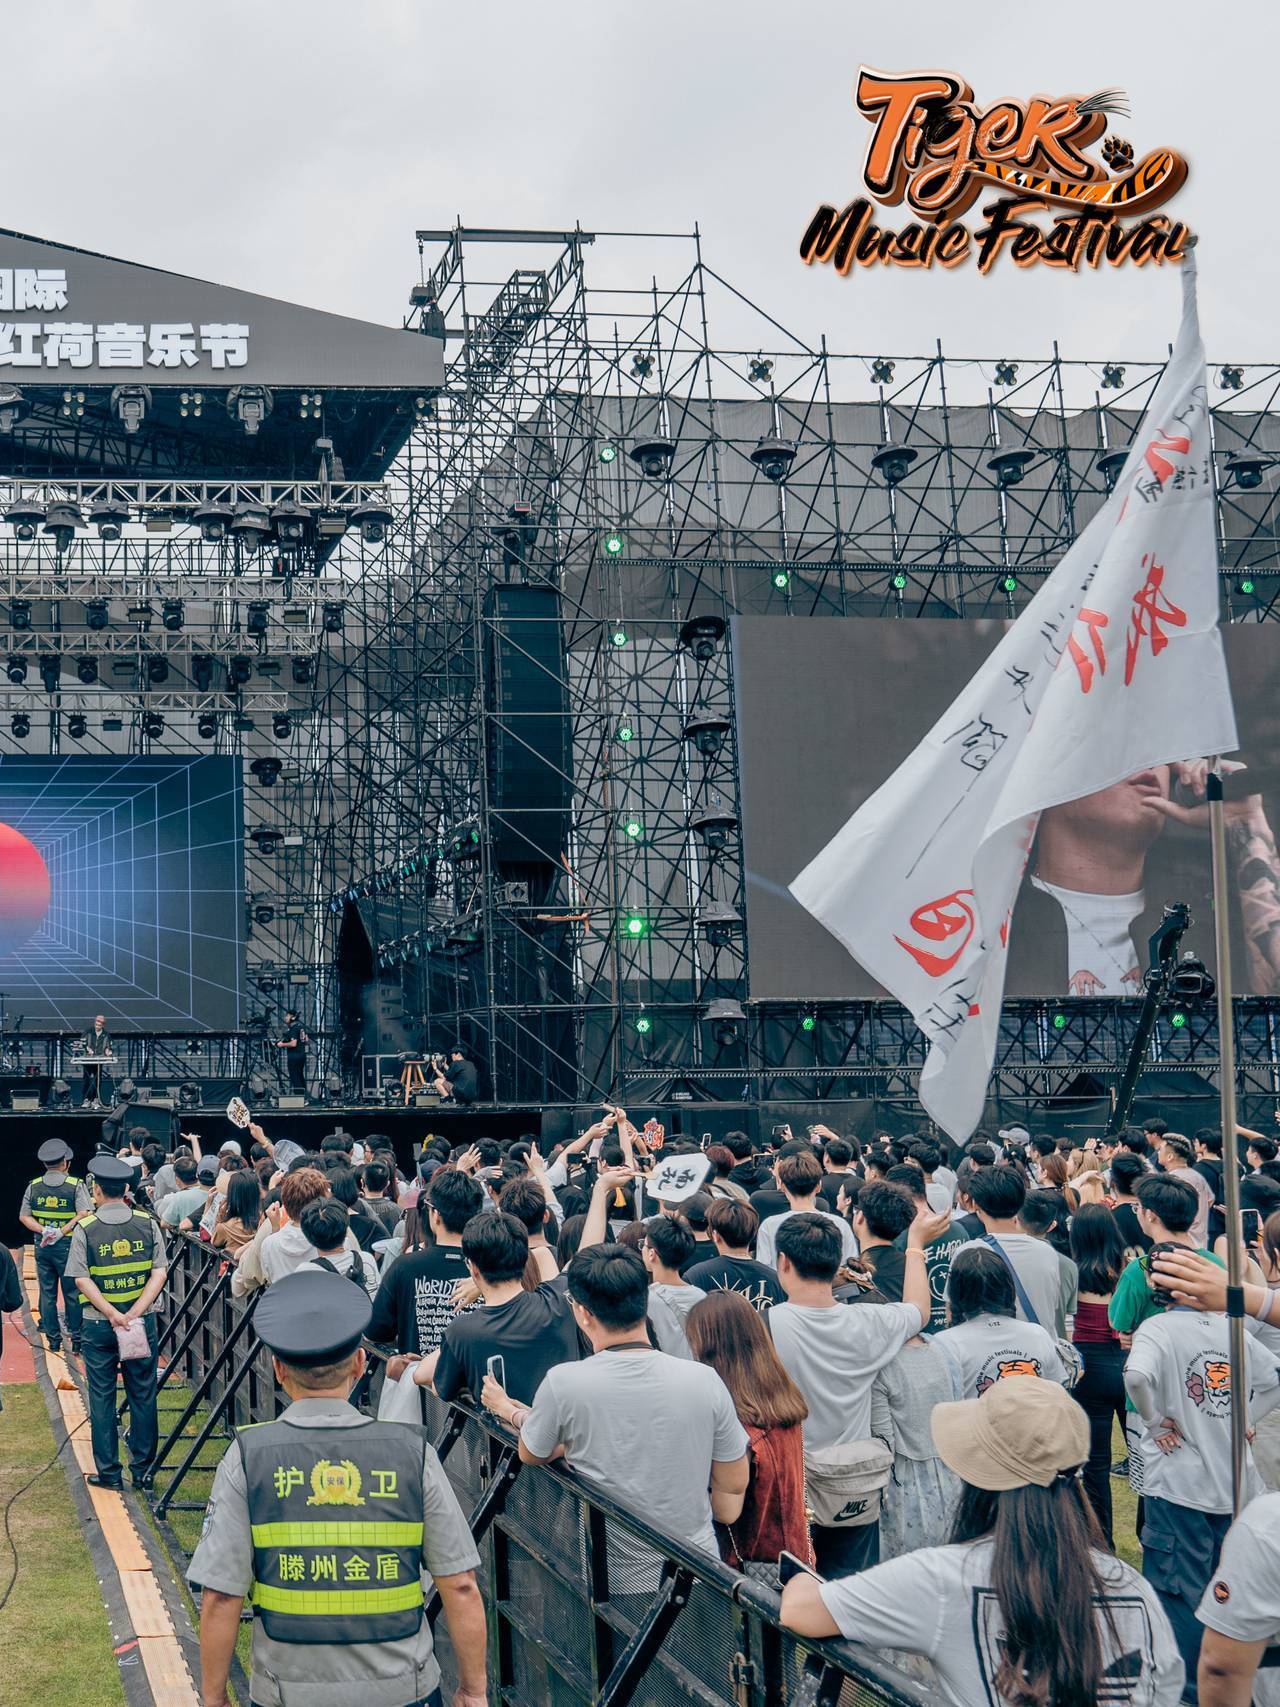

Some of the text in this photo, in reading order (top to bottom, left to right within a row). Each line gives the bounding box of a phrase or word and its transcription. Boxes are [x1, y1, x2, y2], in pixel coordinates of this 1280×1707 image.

[841, 1499, 869, 1514] NIKE
[278, 1552, 401, 1582] 滕州金盾
